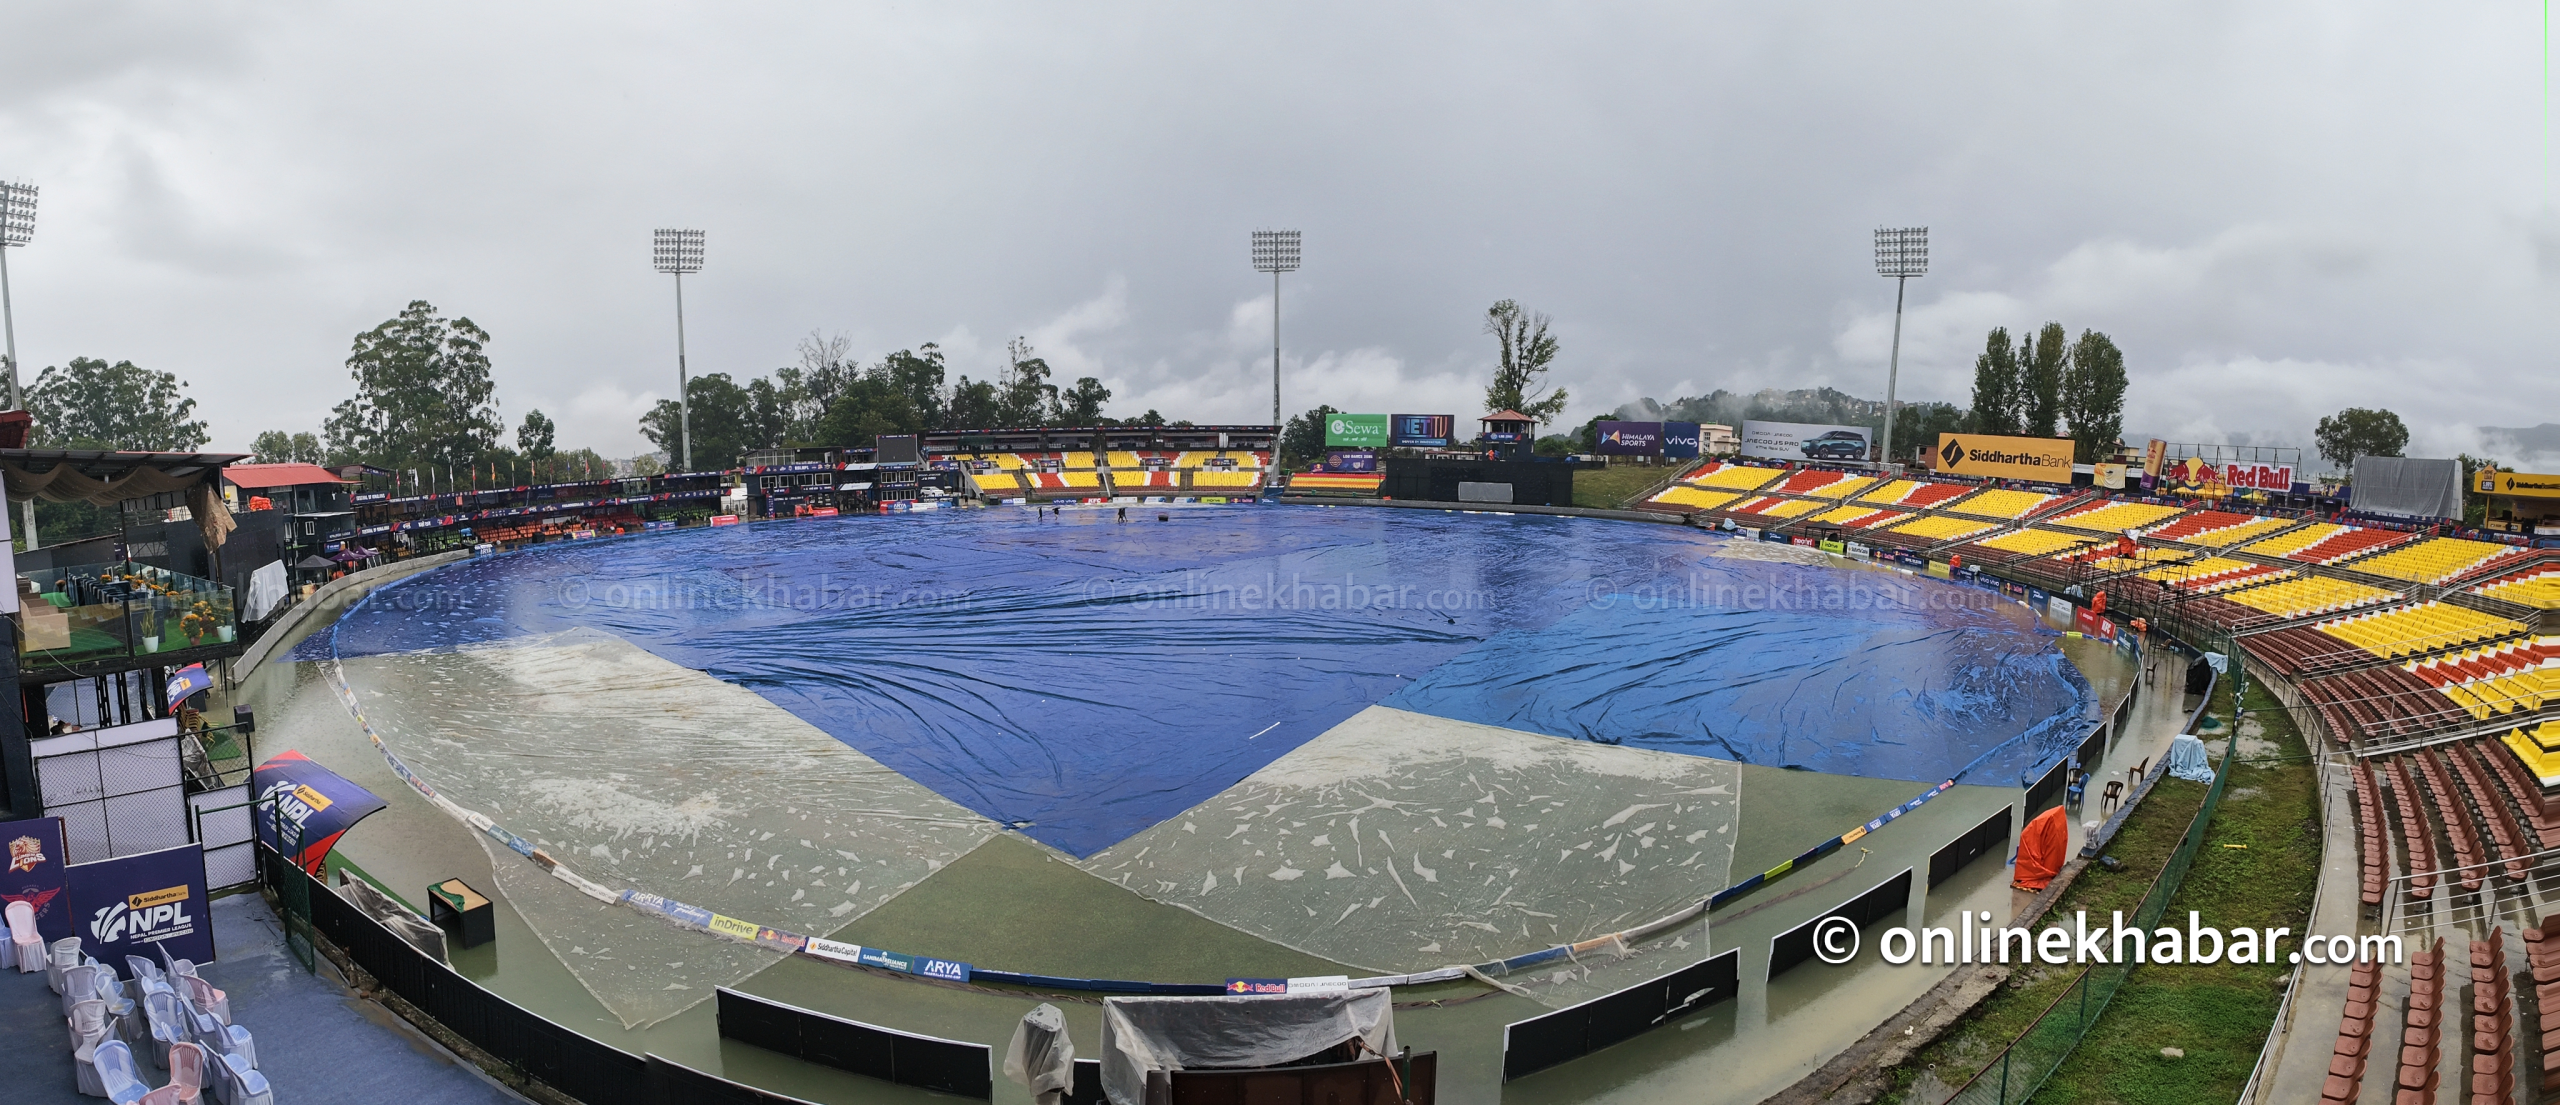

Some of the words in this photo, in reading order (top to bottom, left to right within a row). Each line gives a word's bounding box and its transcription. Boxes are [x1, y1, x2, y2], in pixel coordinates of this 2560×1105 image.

[1622, 433, 1654, 441] HIMALAYA
[1666, 435, 1697, 447] vivo
[2226, 463, 2256, 487] Red
[2257, 465, 2290, 490] Bull
[9, 853, 46, 872] LIONS
[129, 902, 191, 934] NPL
[714, 917, 753, 934] inDrive
[148, 927, 170, 936] PREMIER
[171, 923, 192, 931] LEAGUE
[924, 960, 961, 975] ARYA
[1255, 983, 1271, 992] Red
[1271, 984, 1285, 993] Bull
